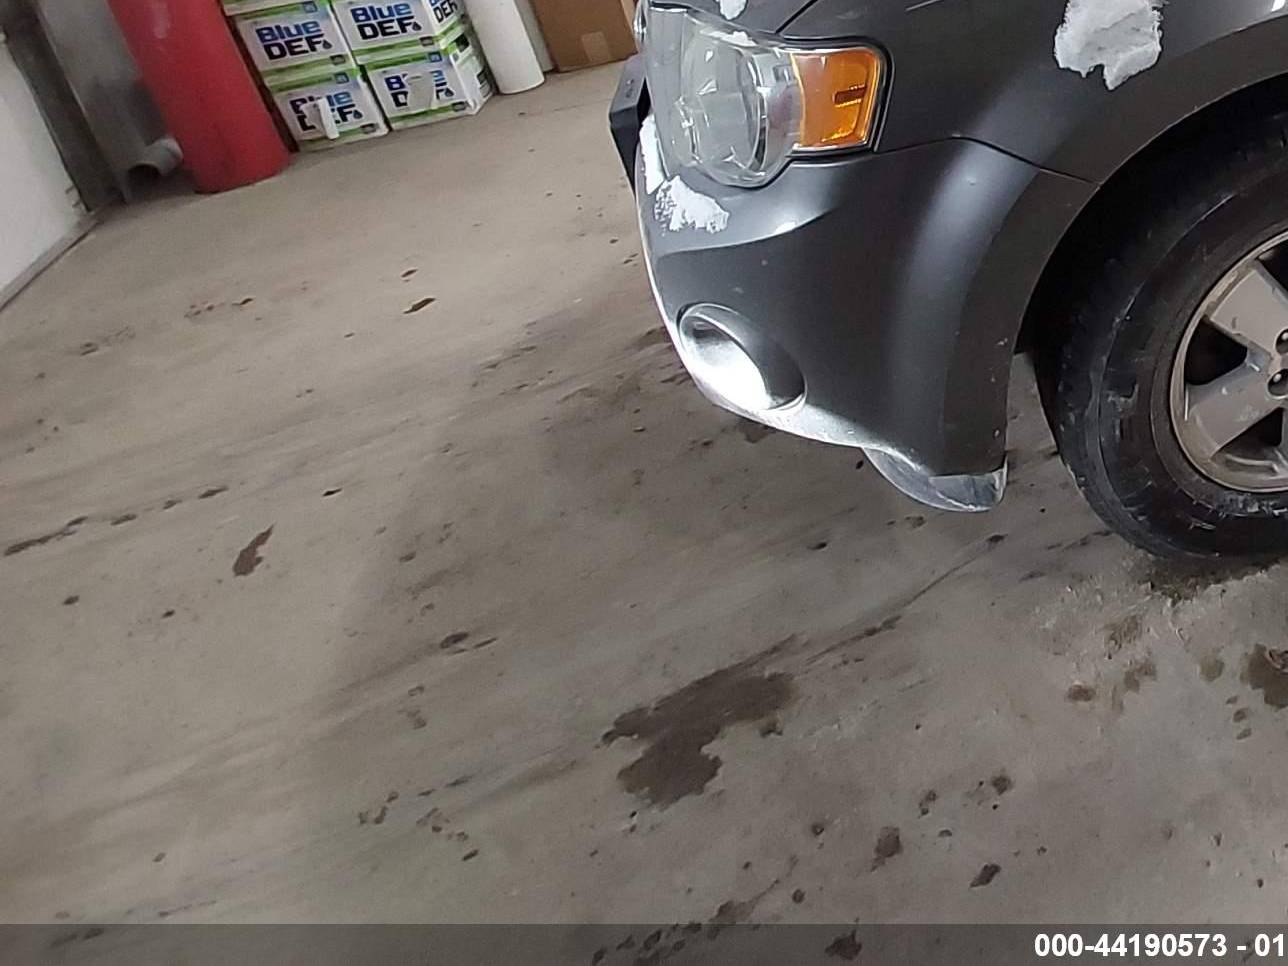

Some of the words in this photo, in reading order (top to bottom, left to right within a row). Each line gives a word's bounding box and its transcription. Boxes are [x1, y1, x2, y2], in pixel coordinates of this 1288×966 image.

[350, 2, 413, 24] Blue
[256, 20, 322, 44] Blue
[357, 15, 415, 41] DEF
[263, 33, 325, 61] DEF
